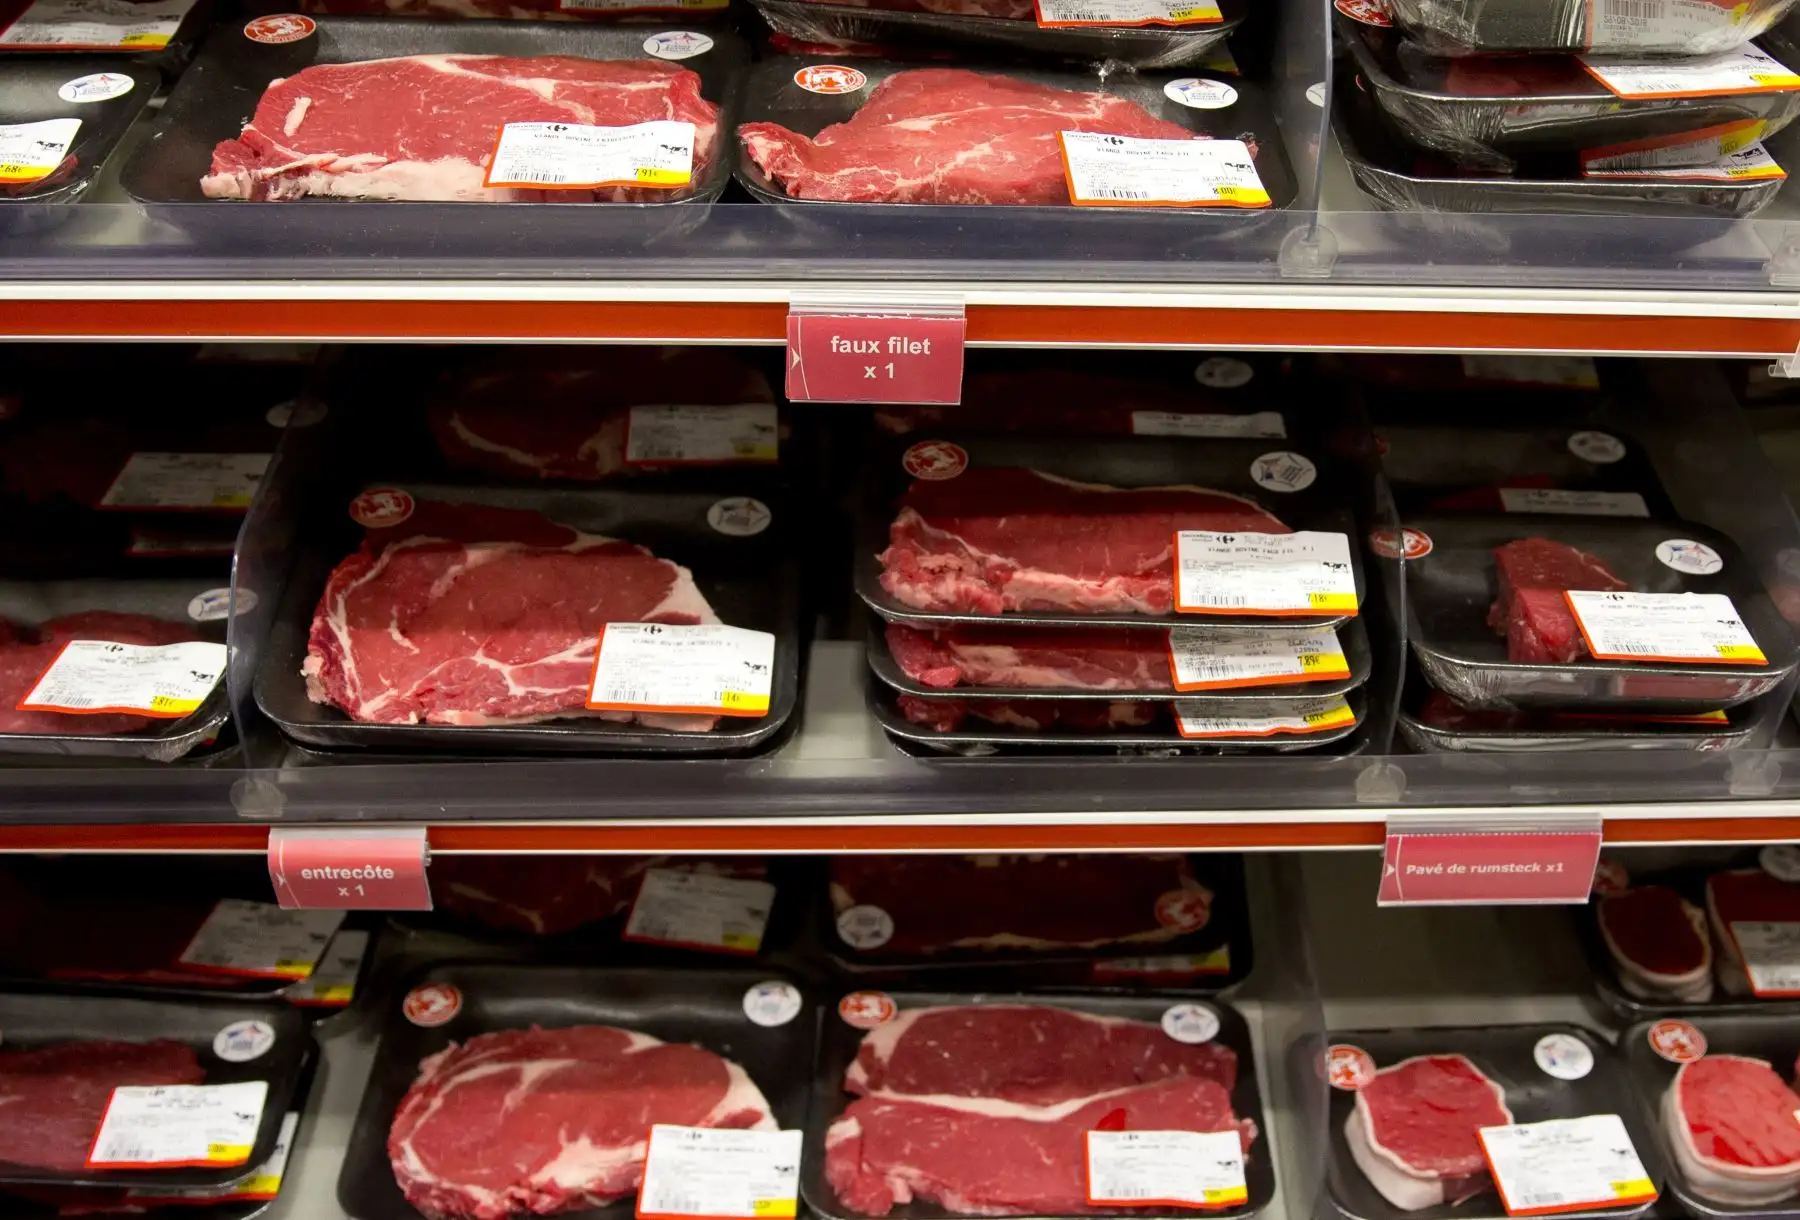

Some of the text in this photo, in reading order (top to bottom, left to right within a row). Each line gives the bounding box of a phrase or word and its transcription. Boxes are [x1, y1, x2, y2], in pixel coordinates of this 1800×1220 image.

[0, 164, 22, 173] .68€
[831, 336, 931, 355] faux filet
[864, 363, 895, 379] x 1
[301, 864, 394, 880] entrecôte
[1406, 861, 1564, 875] Pavé de rumsteck x1
[338, 885, 365, 897] x 1
